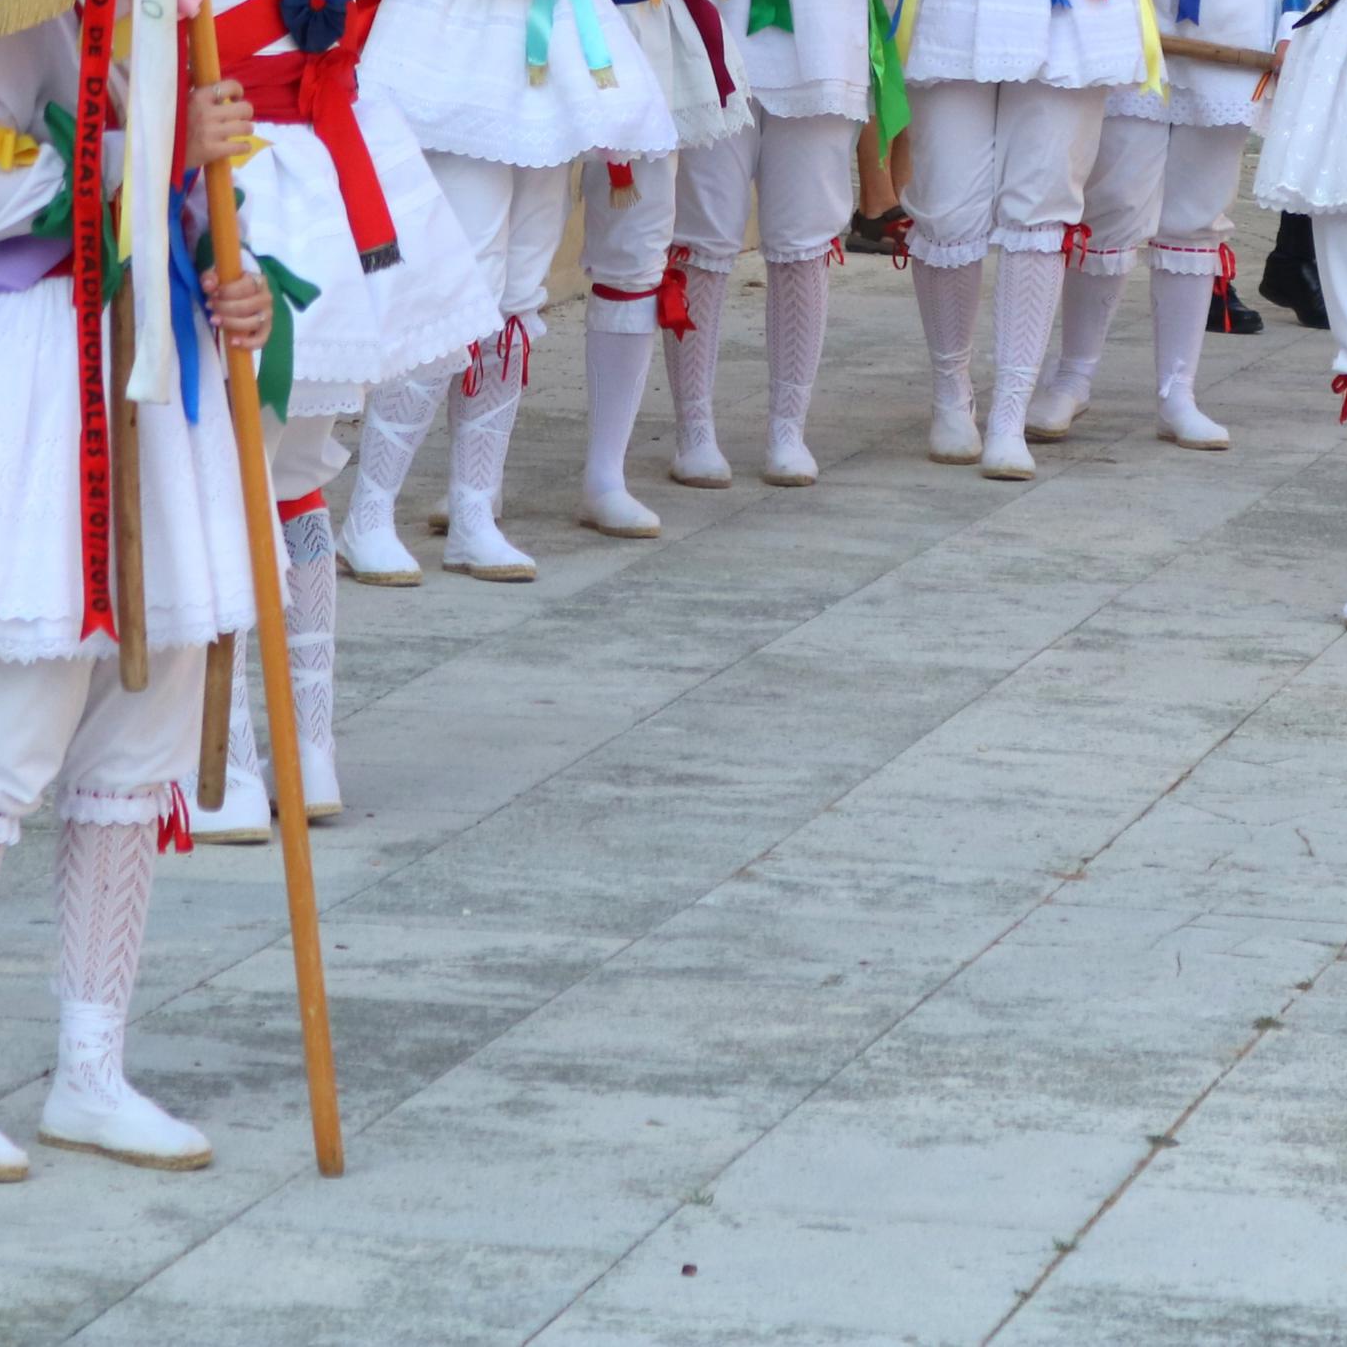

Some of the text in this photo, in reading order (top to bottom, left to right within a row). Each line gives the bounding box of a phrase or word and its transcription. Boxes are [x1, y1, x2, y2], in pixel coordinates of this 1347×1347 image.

[86, 25, 105, 58] DE
[76, 76, 105, 200] DANZAS
[78, 218, 104, 459] TRADICIONALES
[85, 469, 110, 614] 24/07/2010
